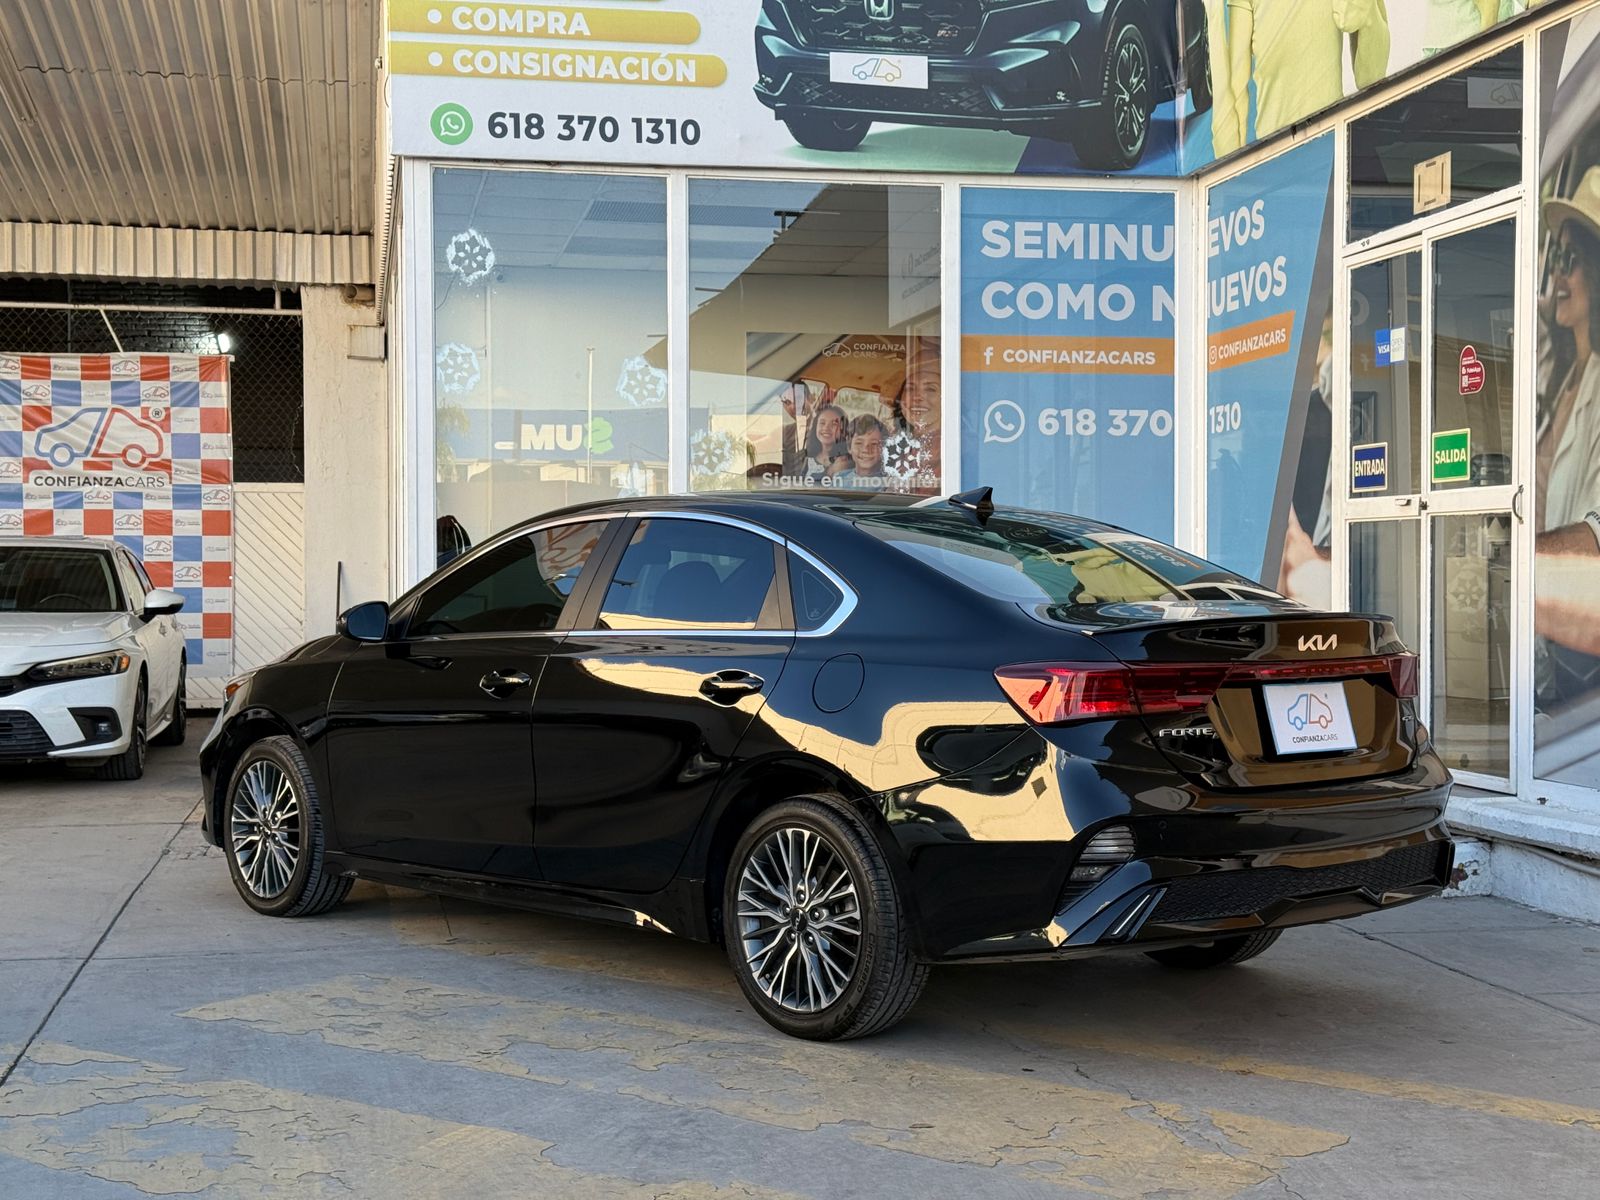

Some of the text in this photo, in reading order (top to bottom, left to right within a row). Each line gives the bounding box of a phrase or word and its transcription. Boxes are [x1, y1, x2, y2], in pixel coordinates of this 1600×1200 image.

[452, 6, 591, 36] COMPRA
[452, 50, 696, 83] CONSIGNACIÓN
[487, 112, 701, 146] 618 370 1310
[980, 220, 1174, 261] SEMINU
[1207, 199, 1265, 257] EVOS
[981, 281, 1136, 321] COMO
[853, 343, 906, 351] CONFIANZA
[1003, 349, 1156, 365] CONFIANZACARS
[1218, 328, 1287, 359] CONFIANZACARS
[1038, 409, 1172, 436] 618 370
[1209, 402, 1242, 433] 1310
[1354, 458, 1385, 477] ENTRADA
[1435, 448, 1467, 465] SALIDA
[33, 476, 165, 488] CONFIANZACARS
[762, 473, 814, 488] Sigue
[821, 474, 843, 487] en
[1159, 727, 1213, 737] FORTE
[1292, 734, 1338, 743] CONFIANZACARS
